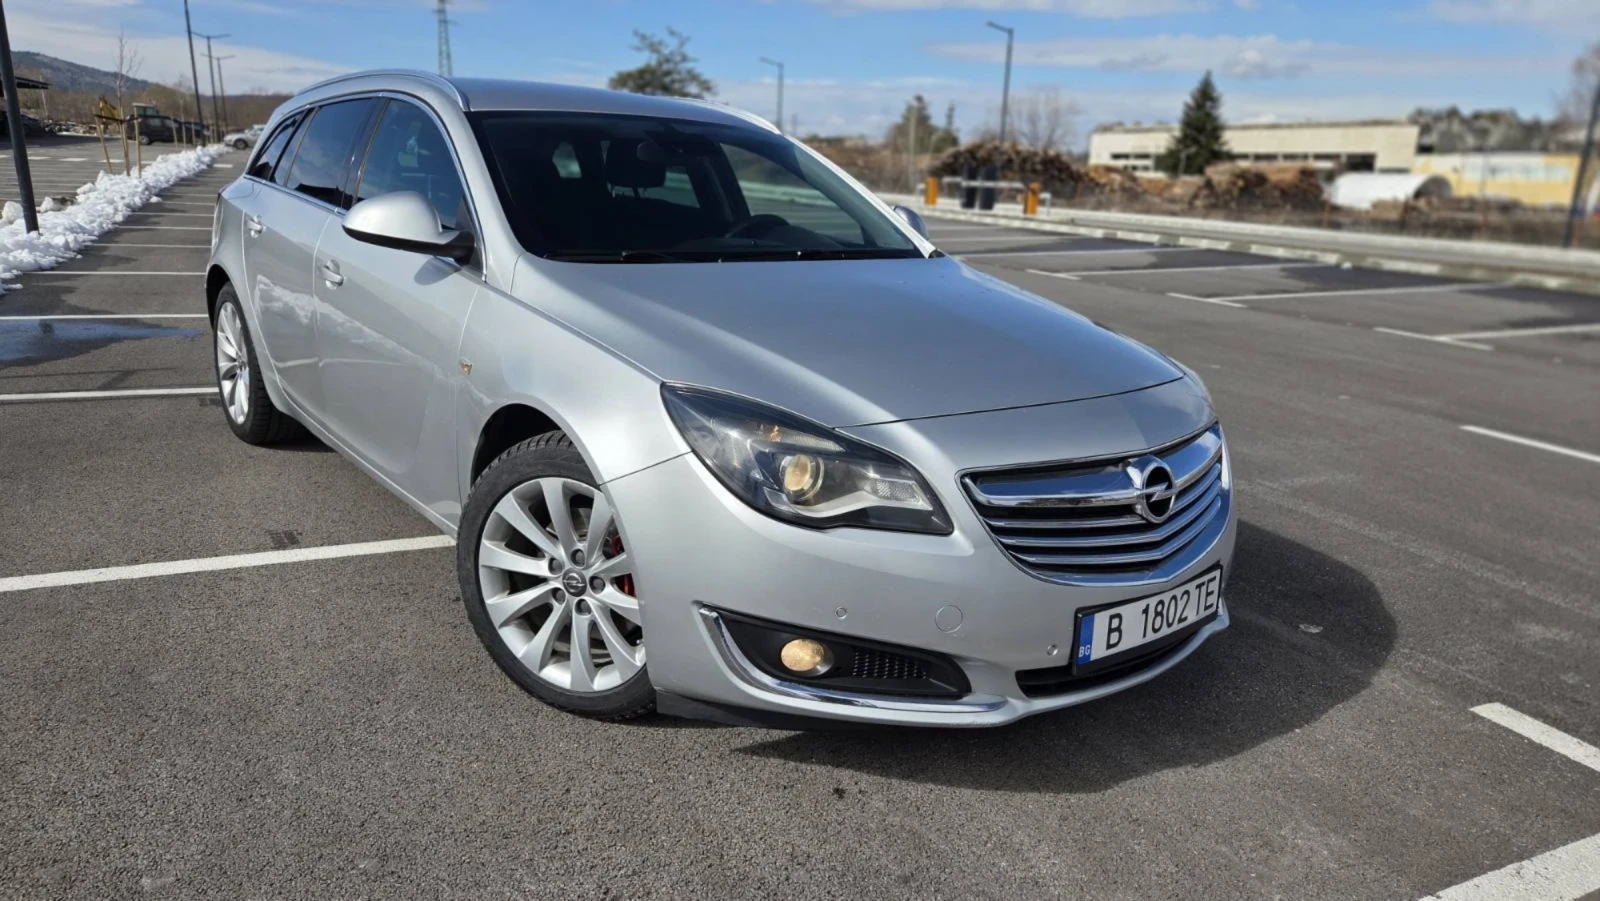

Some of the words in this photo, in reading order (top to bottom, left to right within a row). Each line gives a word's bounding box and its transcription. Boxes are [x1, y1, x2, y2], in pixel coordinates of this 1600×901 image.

[1106, 613, 1123, 650] B
[1142, 590, 1190, 638] 1802
[1195, 576, 1217, 616] TE
[1079, 645, 1091, 658] BG
